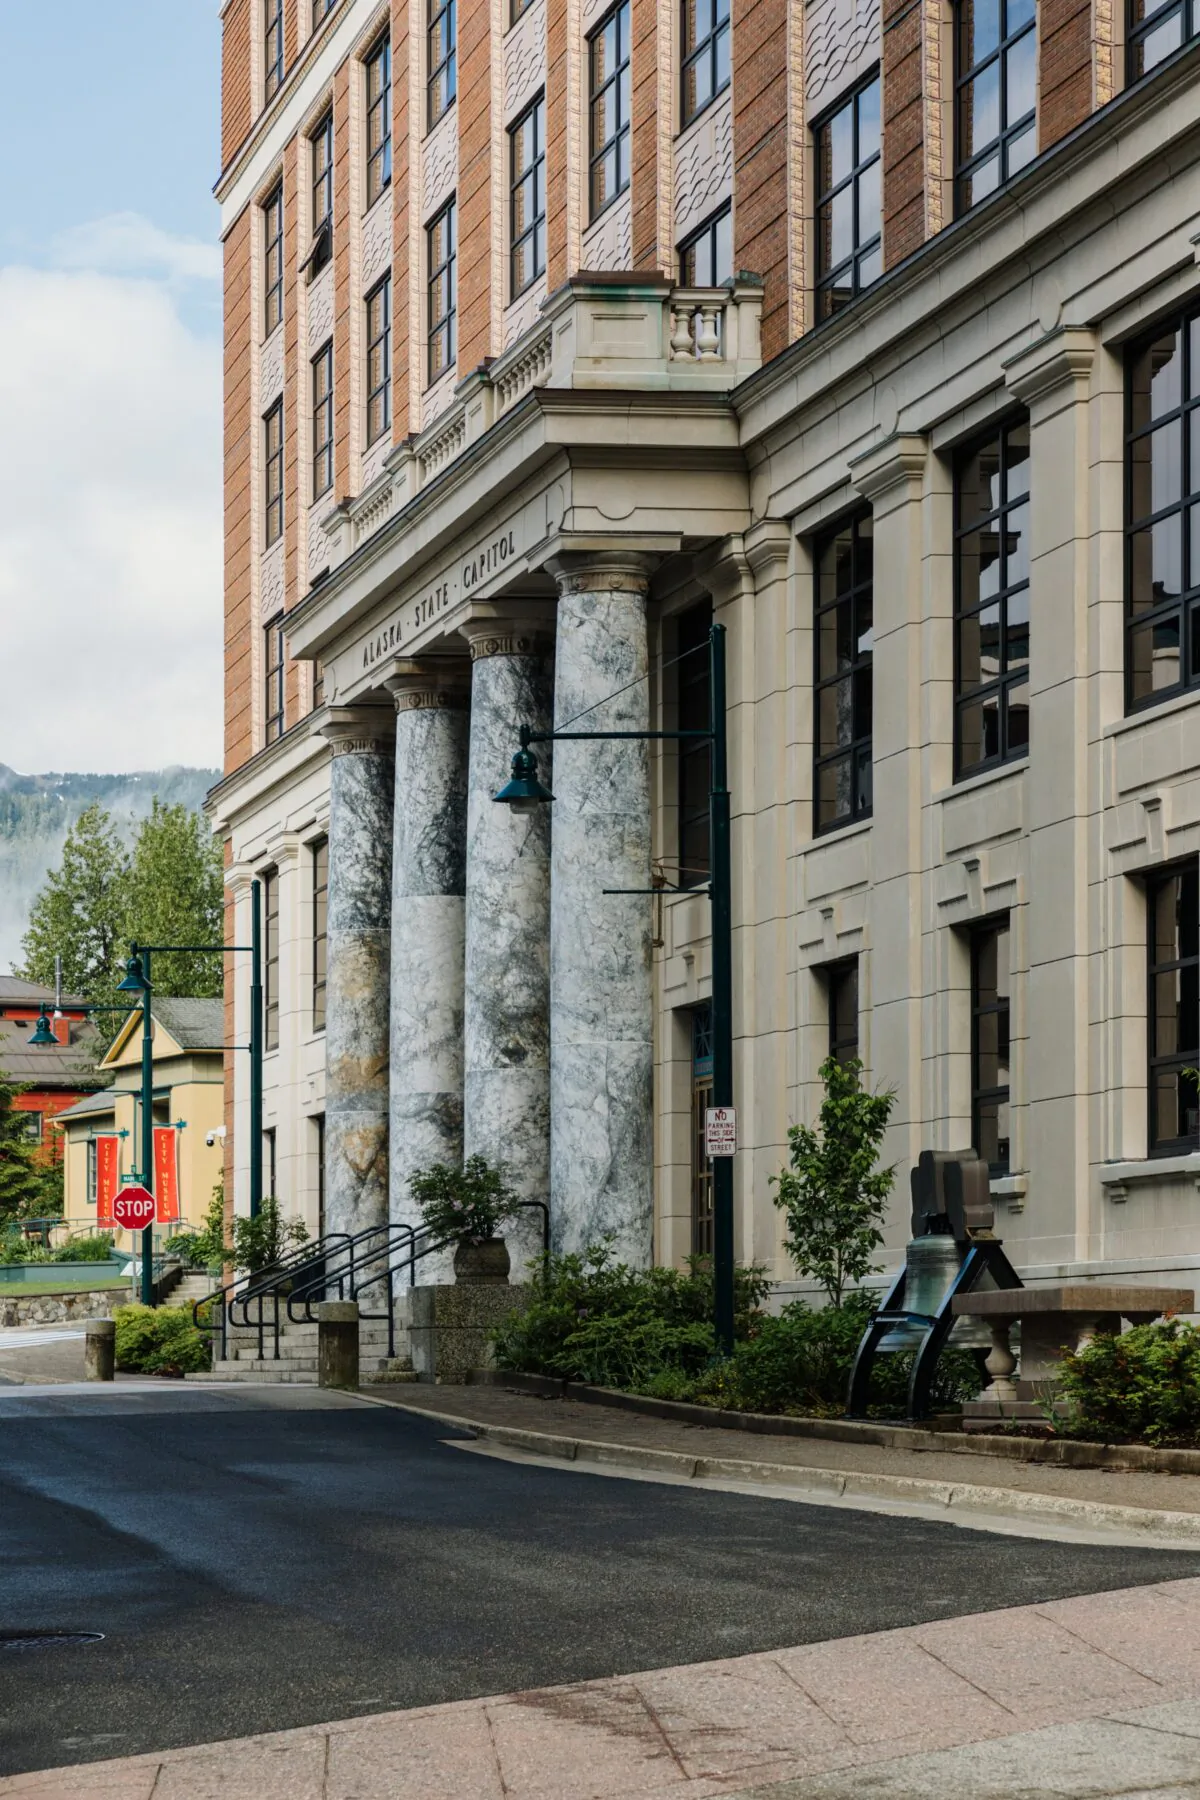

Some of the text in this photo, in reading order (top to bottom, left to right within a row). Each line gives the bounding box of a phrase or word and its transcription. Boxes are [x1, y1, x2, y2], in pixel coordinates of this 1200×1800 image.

[363, 531, 515, 668] ALASKA STATE CAPITOL
[715, 1112, 727, 1121] NO
[115, 1201, 153, 1217] STOP
[162, 1172, 171, 1216] MUSEUM
